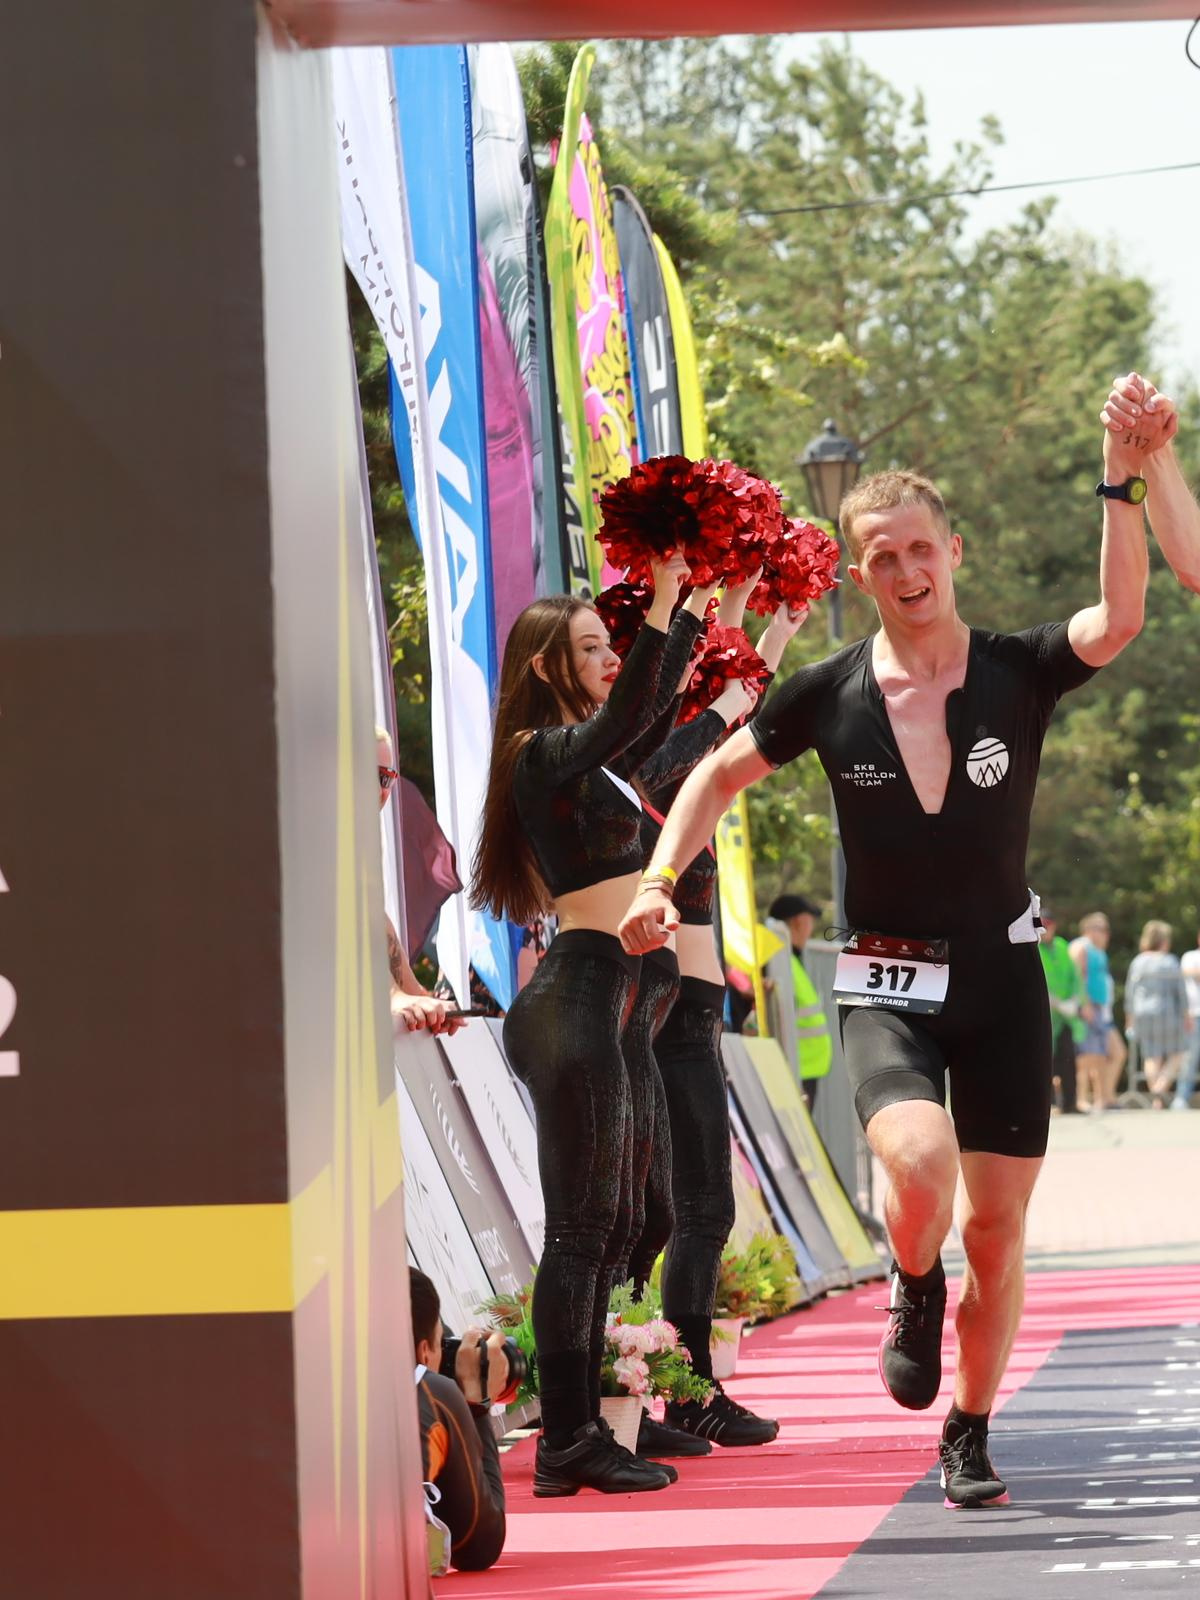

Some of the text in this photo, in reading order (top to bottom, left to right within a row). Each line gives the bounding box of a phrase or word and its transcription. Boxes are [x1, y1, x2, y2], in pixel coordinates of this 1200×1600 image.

[1123, 432, 1150, 450] 317
[853, 779, 882, 787] TEAM
[866, 962, 917, 992] 317
[864, 995, 909, 1007] ALEKSANDR
